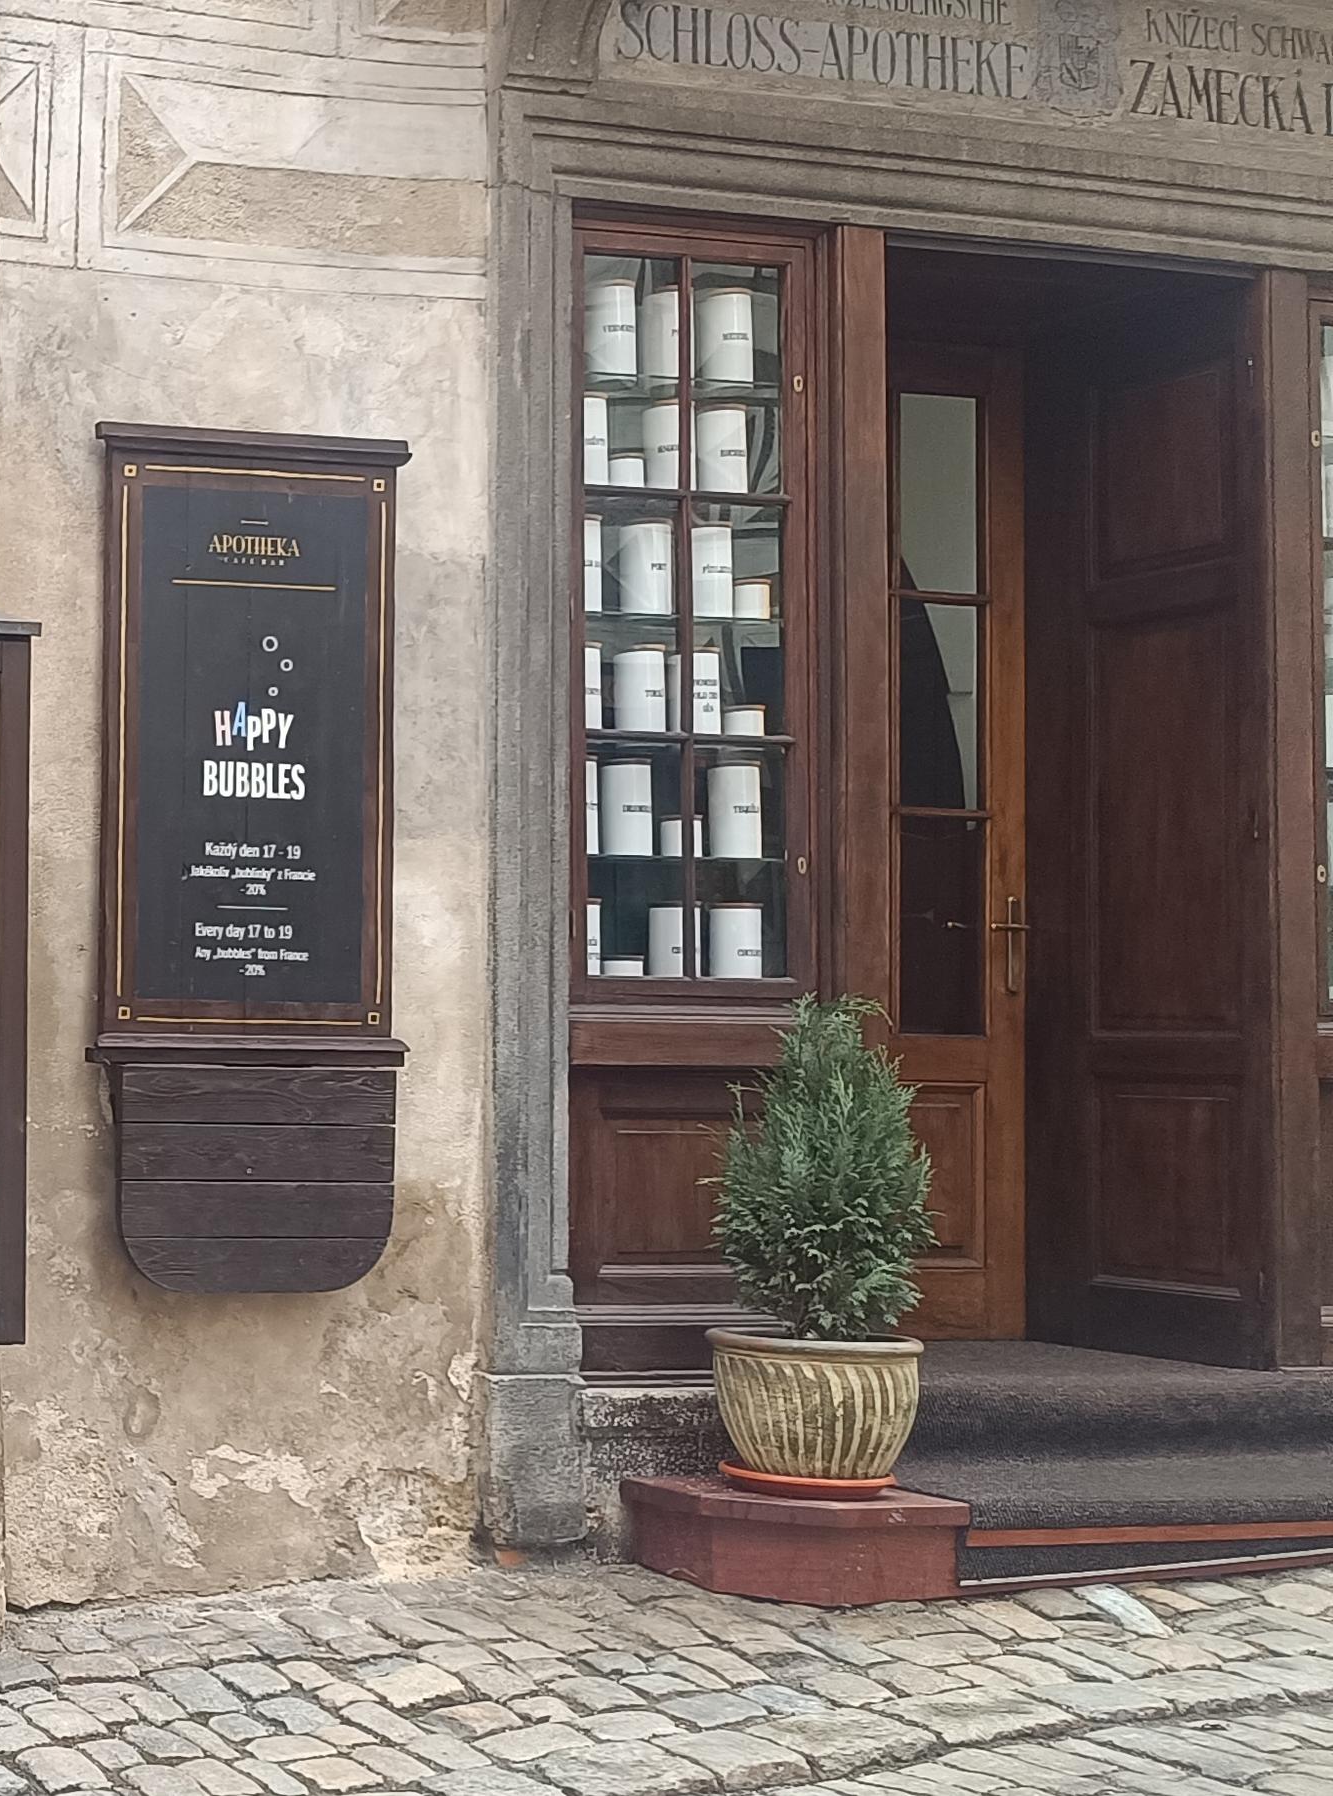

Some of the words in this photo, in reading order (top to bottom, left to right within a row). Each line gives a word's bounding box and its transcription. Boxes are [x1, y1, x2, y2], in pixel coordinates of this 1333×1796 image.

[615, 1, 1029, 100] SCHLOSS-APOTHEKE
[1251, 23, 1333, 65] SCHWA
[1130, 52, 1314, 135] ZÁMECKÁ
[208, 534, 300, 557] APOTHEKA
[214, 701, 294, 751] HAPPY
[203, 760, 305, 800] BUBBLES
[205, 842, 238, 860] Každý
[239, 843, 260, 857] den
[263, 844, 277, 858] 17
[286, 845, 301, 859] 19
[284, 868, 316, 881] Francie
[195, 922, 224, 940] Every
[225, 924, 246, 940] day
[247, 924, 261, 938] 17
[264, 926, 275, 938] to
[278, 925, 293, 939] 19
[195, 946, 211, 960] Any
[258, 948, 278, 960] from
[279, 948, 309, 961] France
